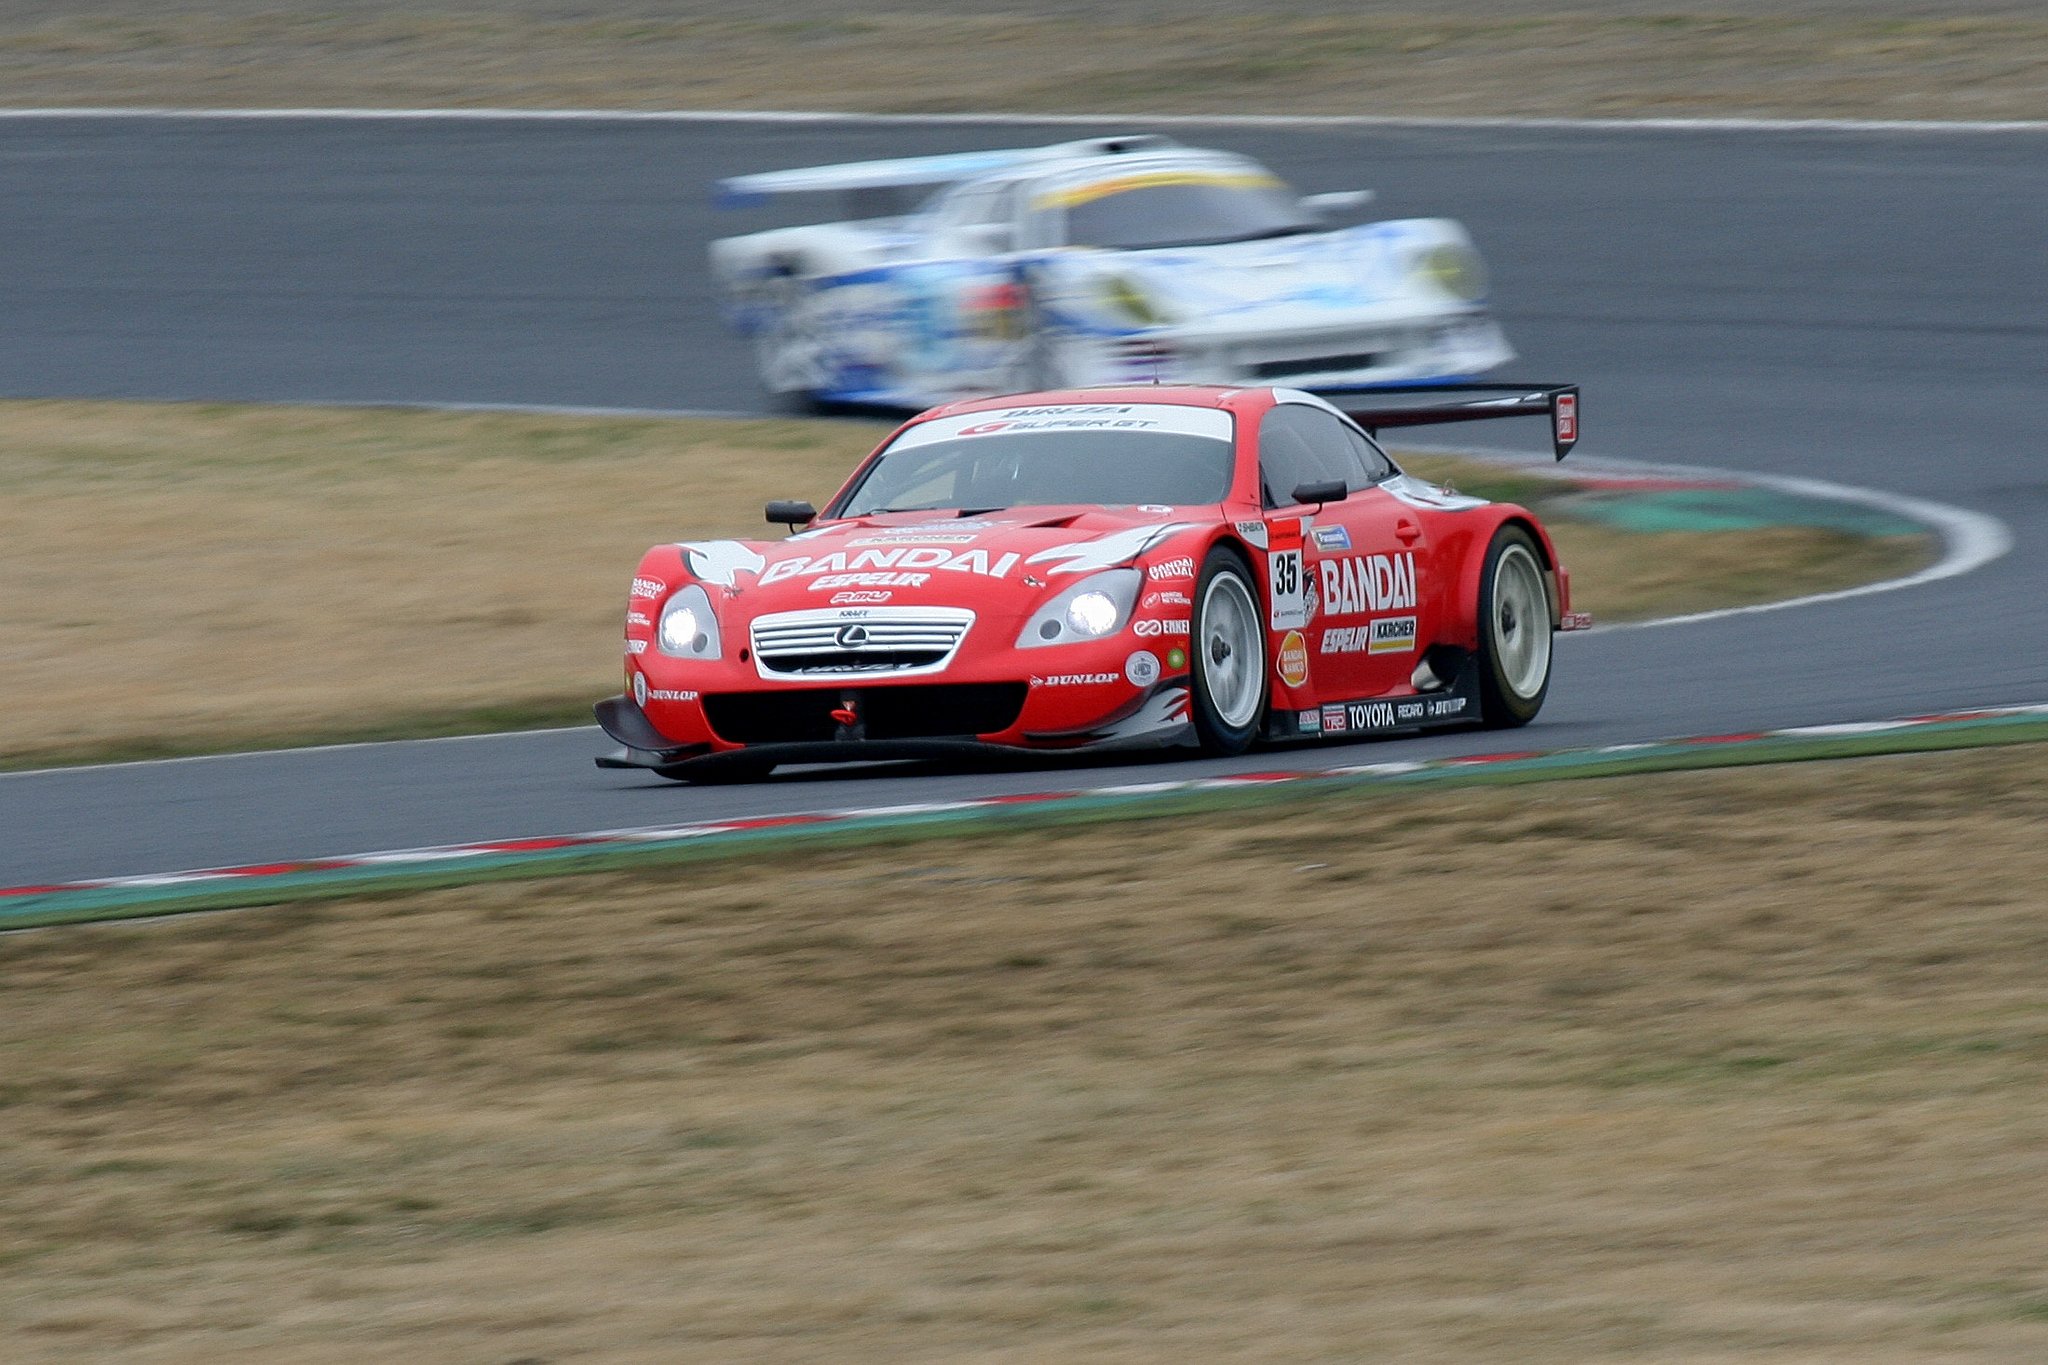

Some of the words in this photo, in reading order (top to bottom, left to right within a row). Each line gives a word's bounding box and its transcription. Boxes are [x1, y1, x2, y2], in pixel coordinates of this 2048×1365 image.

[1008, 420, 1109, 430] SUPER
[1112, 419, 1159, 428] GT
[758, 548, 1020, 586] BANDAI
[1275, 553, 1297, 596] 35
[807, 572, 931, 590] ESPELIR
[1319, 551, 1417, 616] BANDAI
[1321, 626, 1368, 654] ESPELIR
[1045, 673, 1119, 686] DUNLOP
[652, 690, 698, 700] DUNLOP
[1350, 703, 1395, 729] TOYOTA
